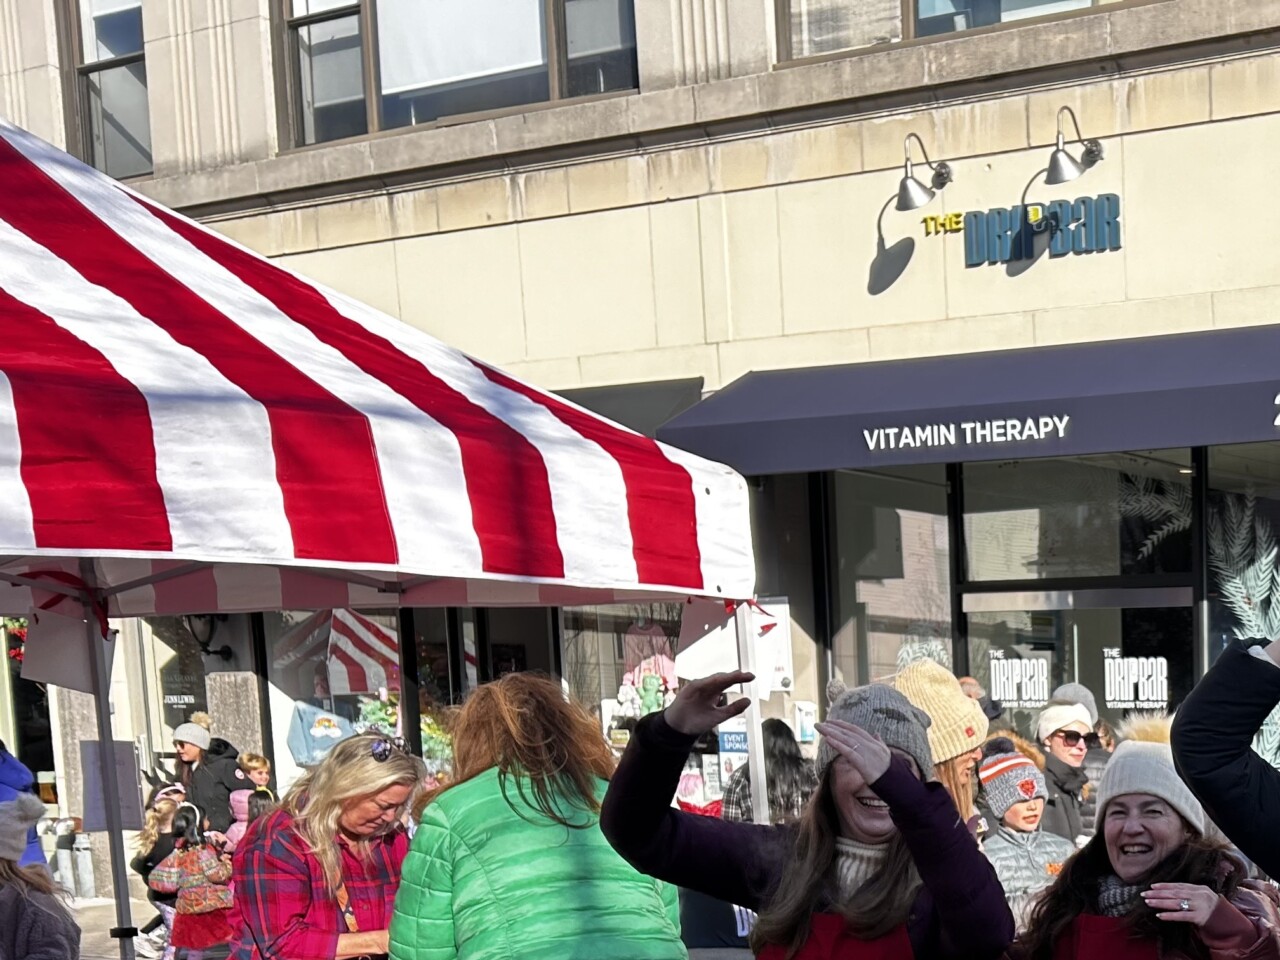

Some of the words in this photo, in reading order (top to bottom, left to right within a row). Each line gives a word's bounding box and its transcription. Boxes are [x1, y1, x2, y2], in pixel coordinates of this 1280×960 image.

[921, 213, 965, 237] THE
[863, 424, 957, 451] VITAMIN
[961, 414, 1070, 443] THERAPY
[989, 650, 1004, 659] THE
[1102, 647, 1121, 657] THE
[1105, 701, 1135, 709] VITAMIN
[1135, 701, 1168, 709] THERAPY
[724, 734, 744, 742] EVENT
